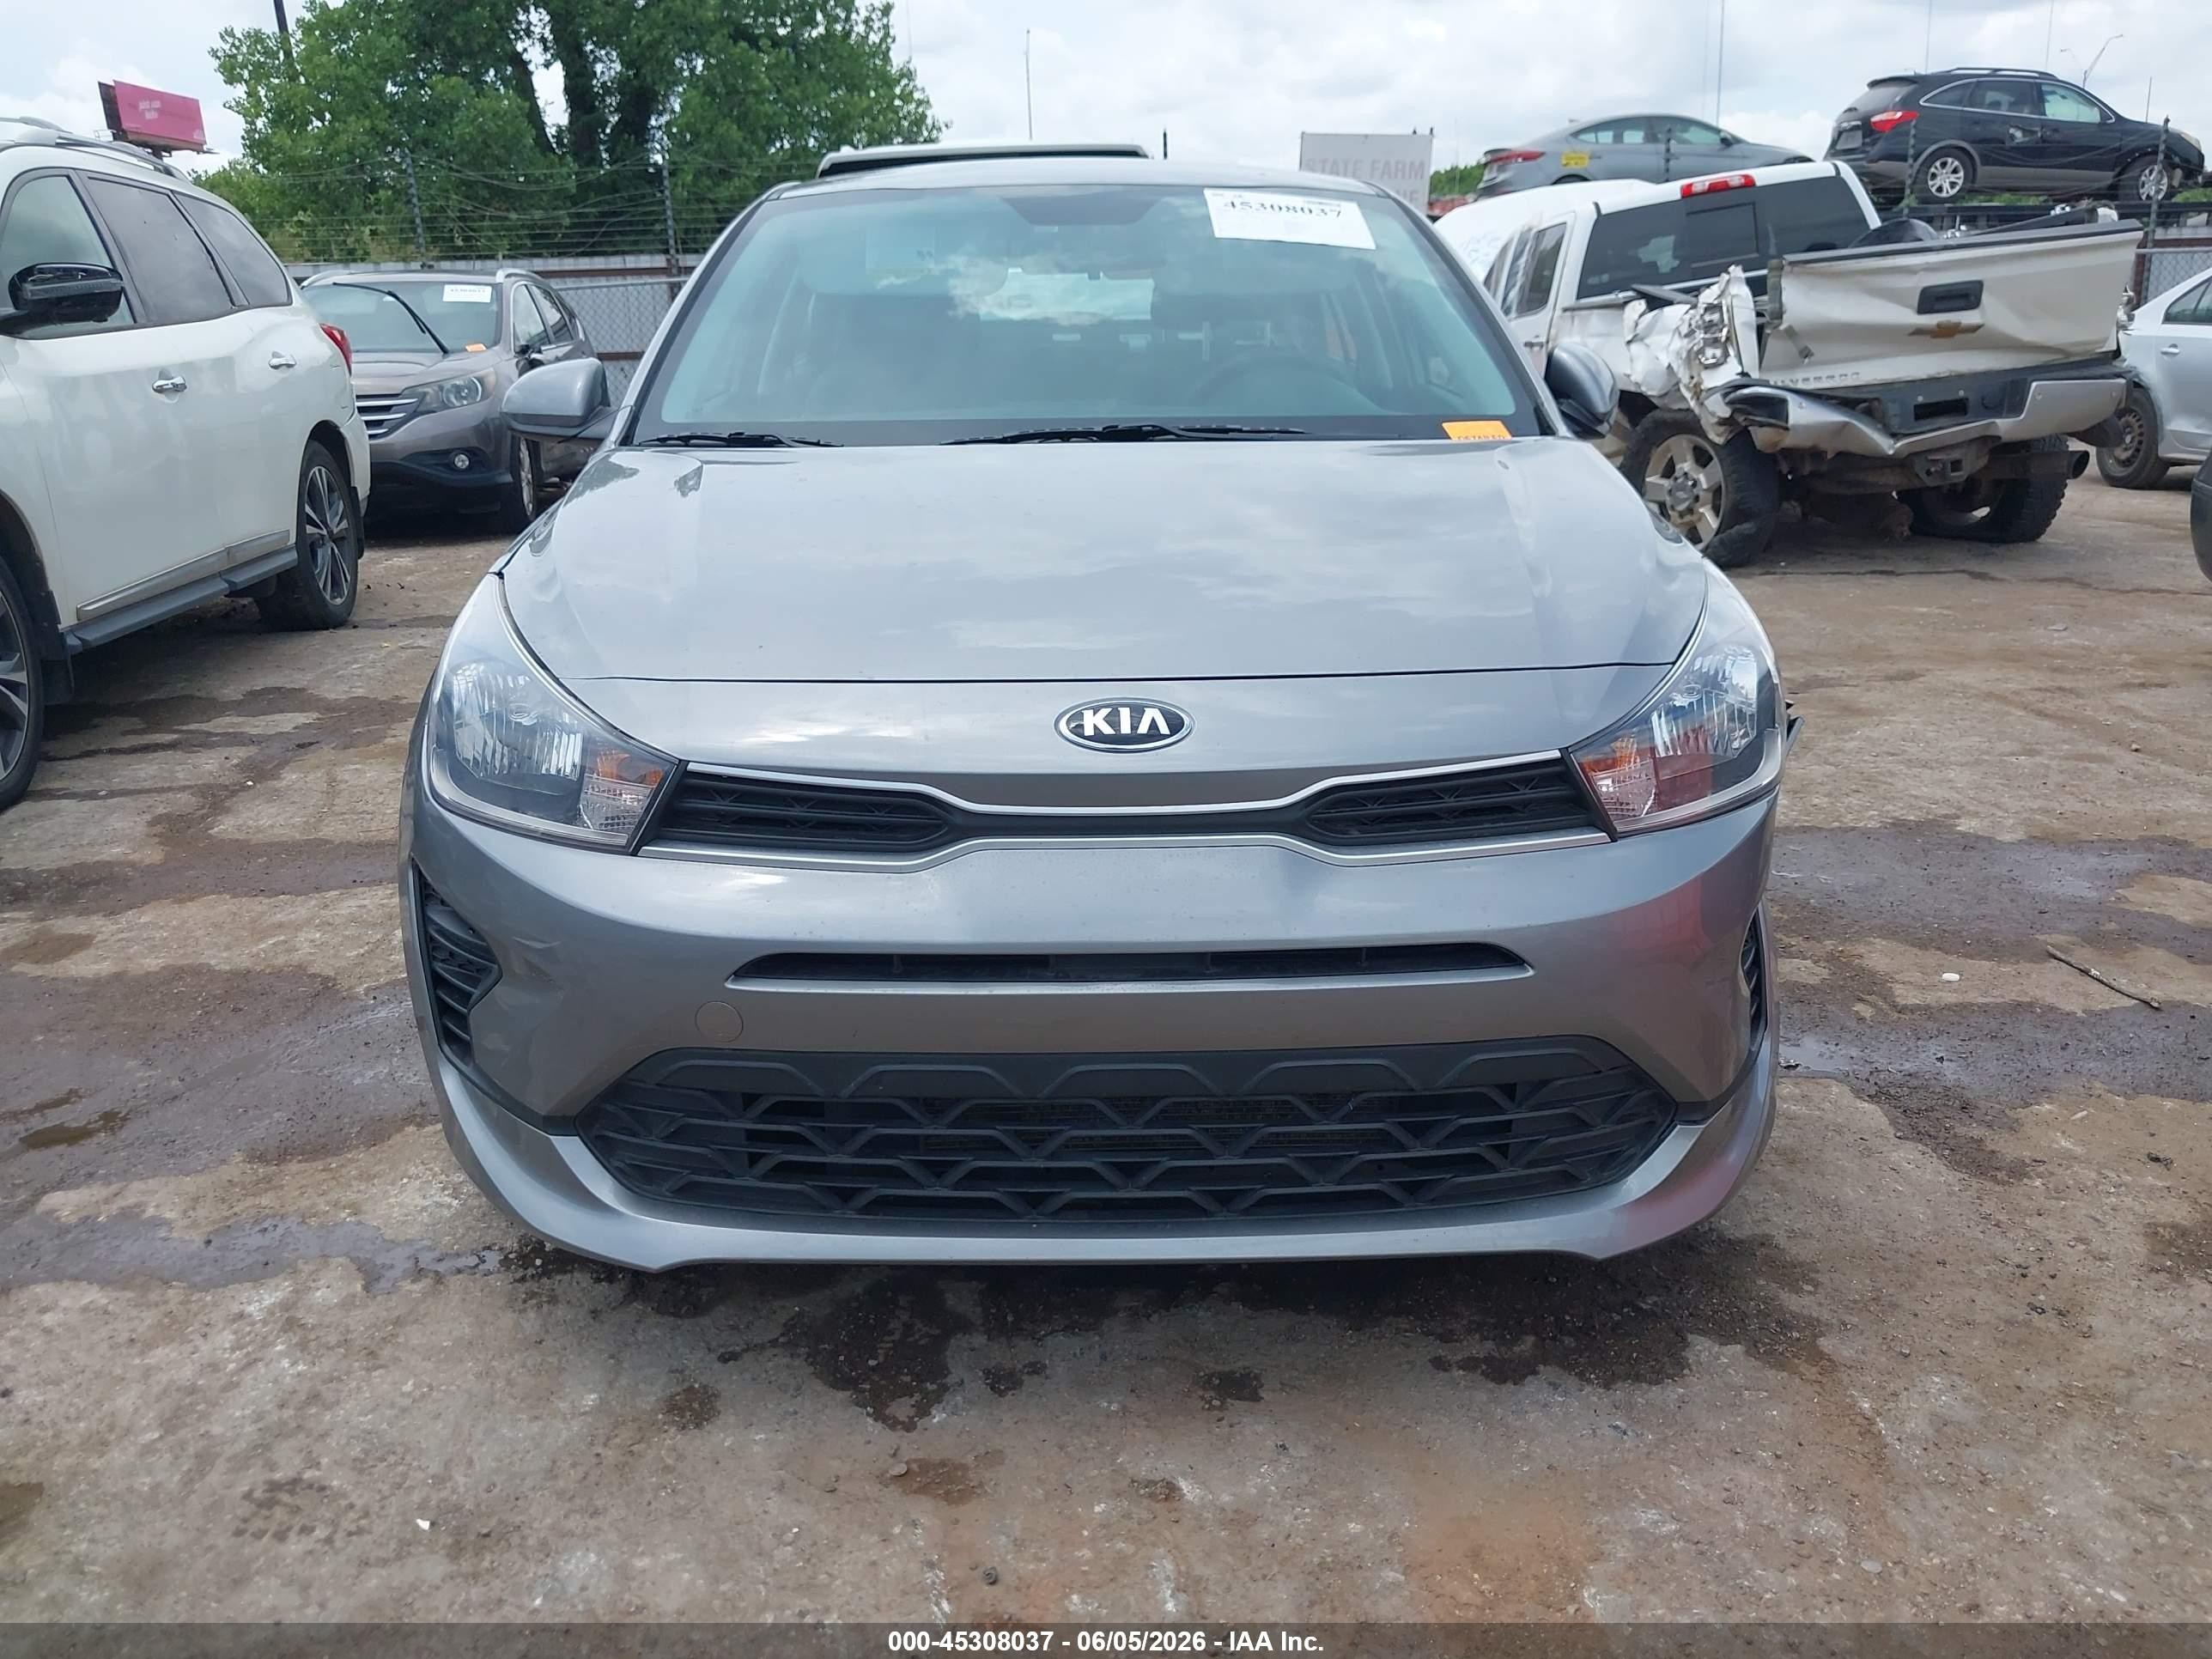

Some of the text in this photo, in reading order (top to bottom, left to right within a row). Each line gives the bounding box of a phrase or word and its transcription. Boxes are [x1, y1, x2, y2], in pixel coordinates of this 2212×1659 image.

[1305, 158, 1425, 179] STATE FARM
[1224, 200, 1341, 218] 45308037
[1081, 707, 1171, 737] KIA
